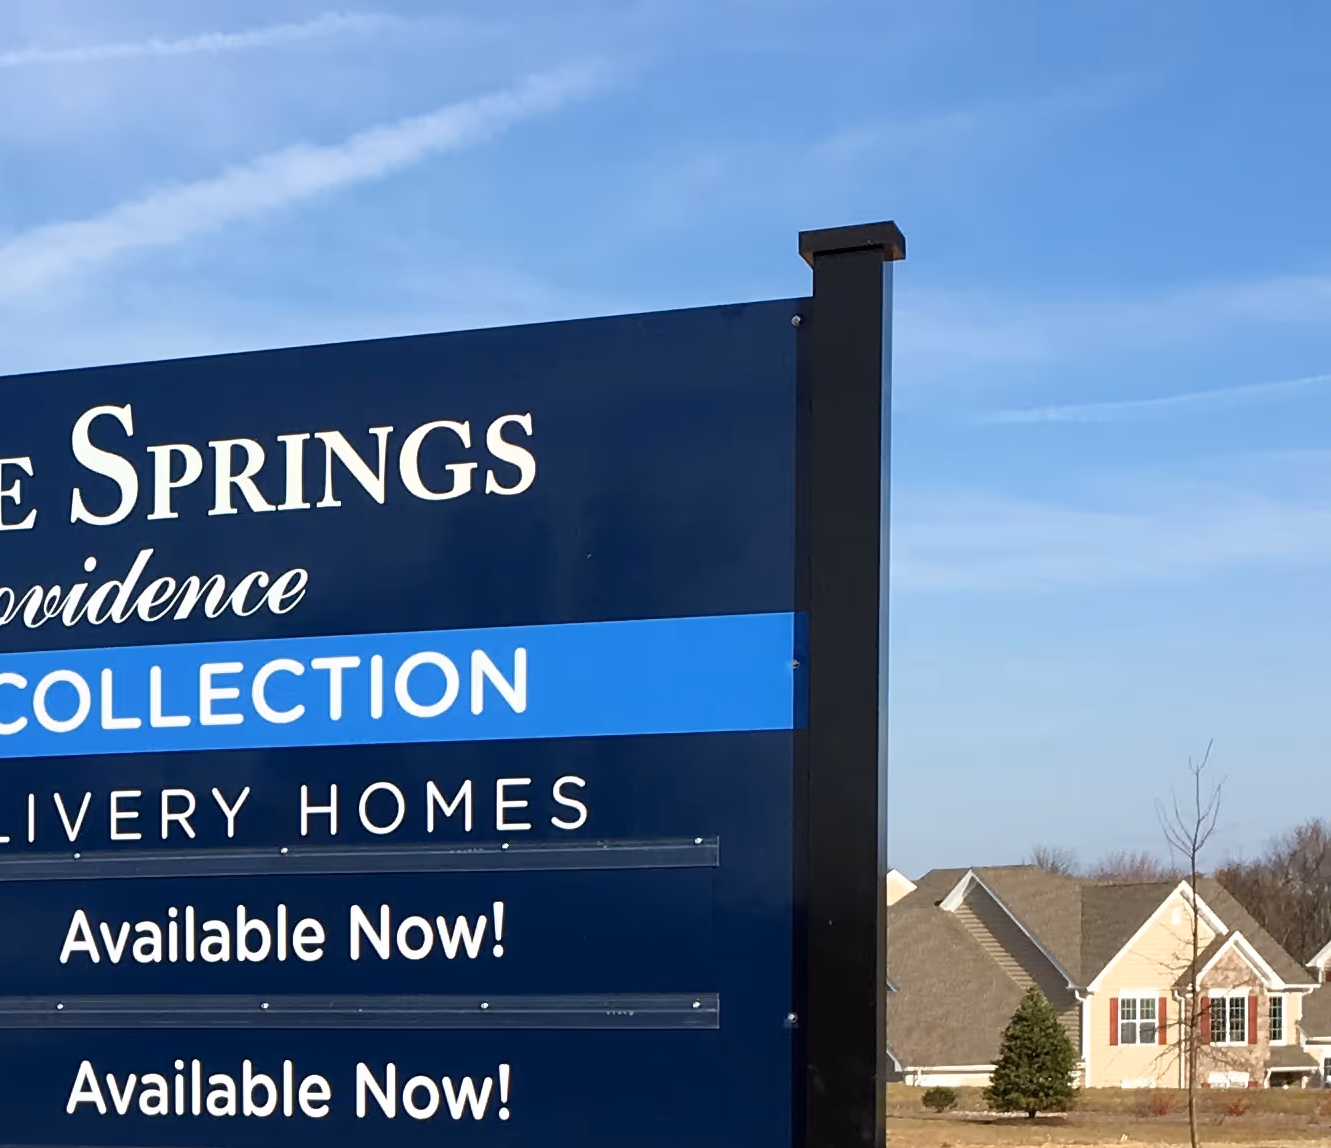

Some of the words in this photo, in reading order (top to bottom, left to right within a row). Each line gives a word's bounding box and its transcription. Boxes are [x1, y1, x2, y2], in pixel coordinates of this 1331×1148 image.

[300, 775, 589, 836] HOMES
[59, 903, 325, 964] Available
[350, 900, 506, 961] Now!
[66, 1058, 332, 1118] Available
[356, 1062, 512, 1120] Now!
